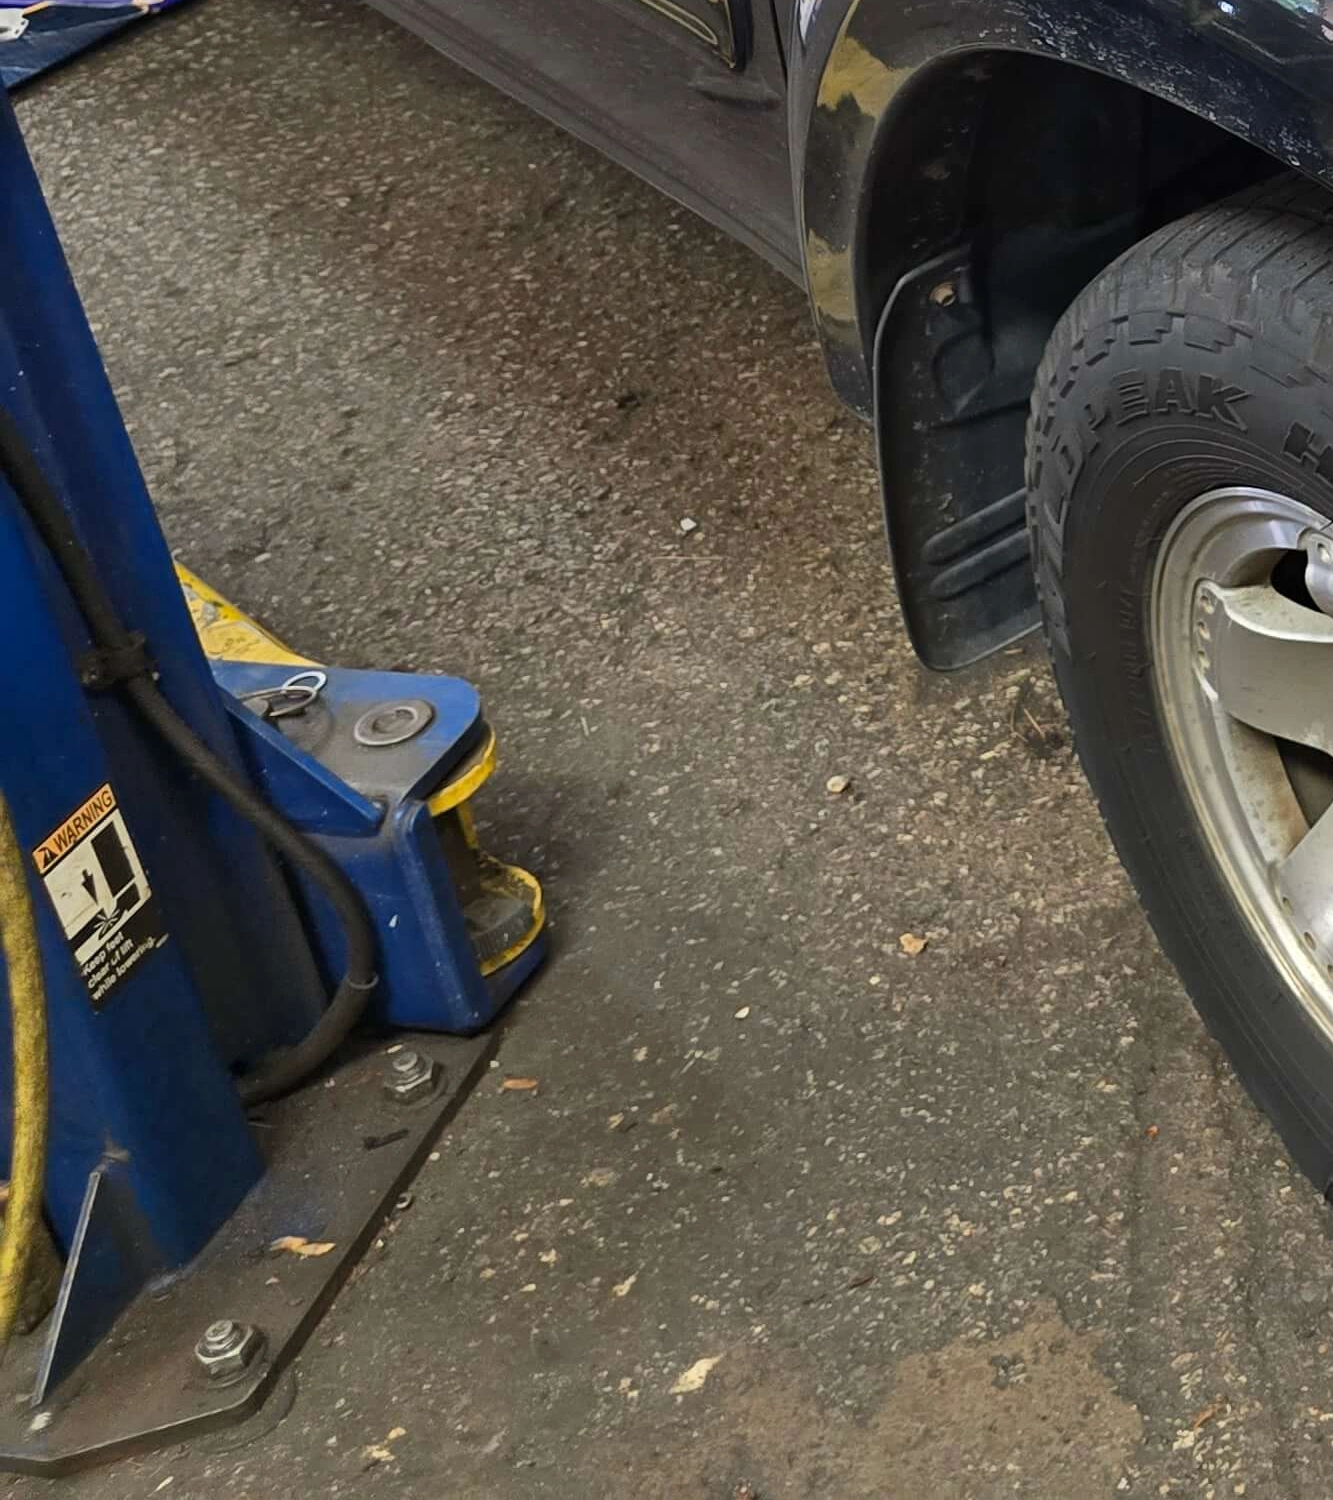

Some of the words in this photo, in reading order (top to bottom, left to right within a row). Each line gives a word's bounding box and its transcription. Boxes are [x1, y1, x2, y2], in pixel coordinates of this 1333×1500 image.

[54, 789, 113, 852] WARNING
[82, 950, 106, 976] Keep
[87, 962, 110, 989] clear
[110, 949, 121, 967] of
[120, 938, 134, 956] lift
[92, 974, 117, 1000] while
